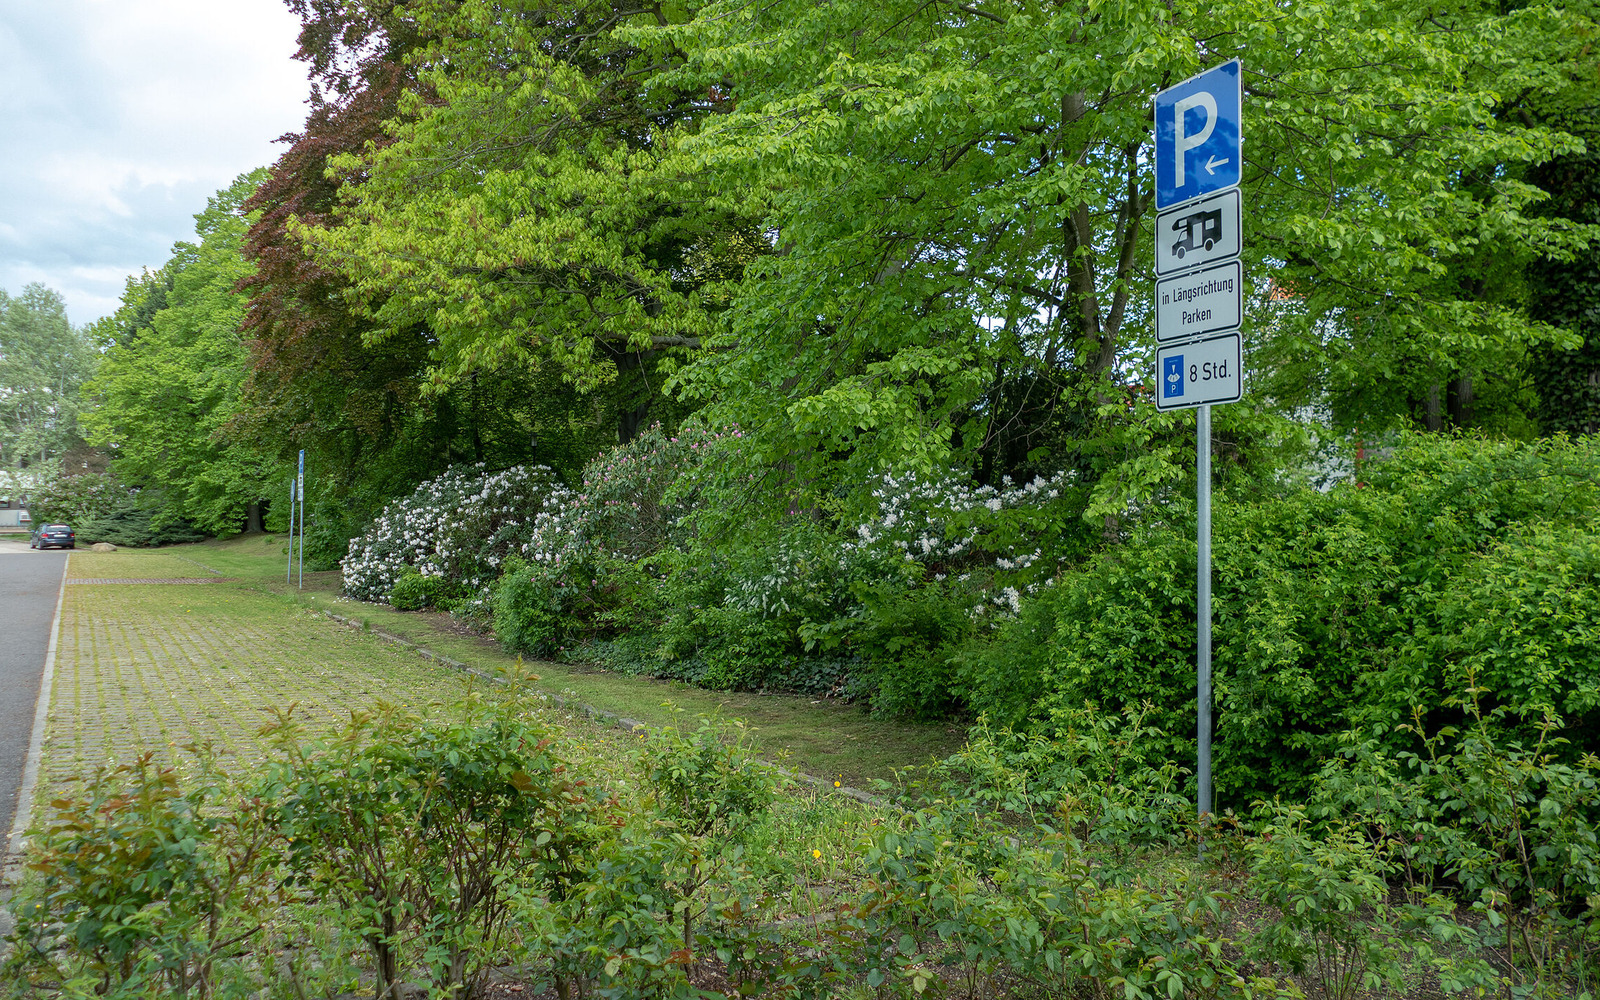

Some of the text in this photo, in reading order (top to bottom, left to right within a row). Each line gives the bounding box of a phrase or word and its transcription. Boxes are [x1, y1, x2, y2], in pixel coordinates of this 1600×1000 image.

[1174, 91, 1218, 189] P
[1162, 278, 1234, 305] in Längsrichtung
[1182, 308, 1212, 326] Parken
[1189, 359, 1232, 383] 8 Std.
[1171, 384, 1177, 394] P
